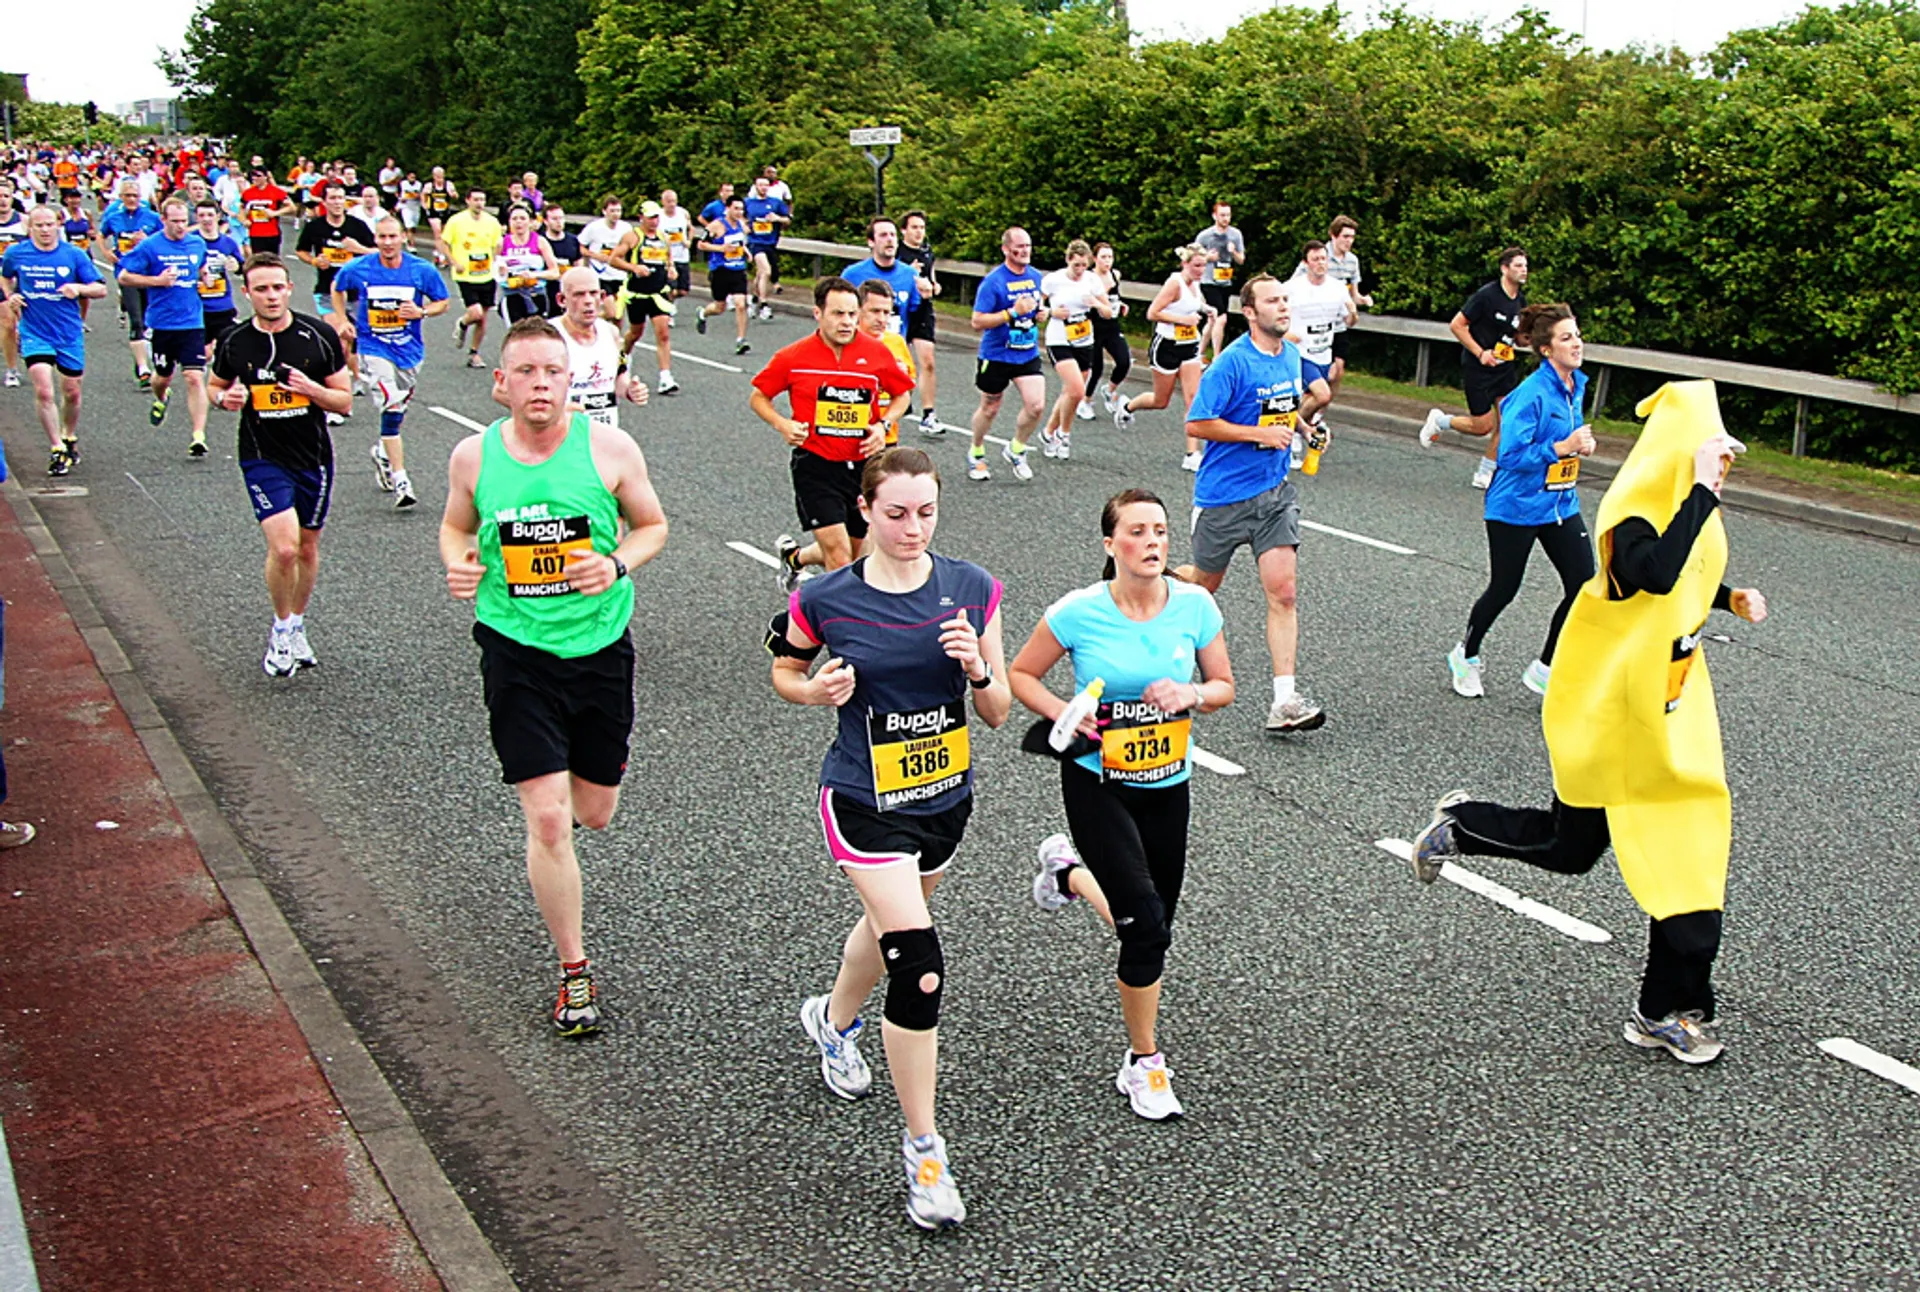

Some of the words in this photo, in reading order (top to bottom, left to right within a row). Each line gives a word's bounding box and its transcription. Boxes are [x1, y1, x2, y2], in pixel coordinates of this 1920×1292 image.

[270, 392, 292, 405] 676
[258, 407, 309, 419] MANCHESTER
[827, 409, 858, 424] 5036
[512, 521, 567, 543] Bupa
[531, 555, 565, 575] 407
[886, 706, 948, 734] Bupa
[1112, 702, 1163, 724] Bupa
[904, 737, 943, 754] LAURIAN
[1123, 736, 1171, 763] 3734
[898, 746, 950, 779] 1386
[1109, 761, 1181, 782] MANCHESTER
[884, 774, 963, 806] MANCHESTER
